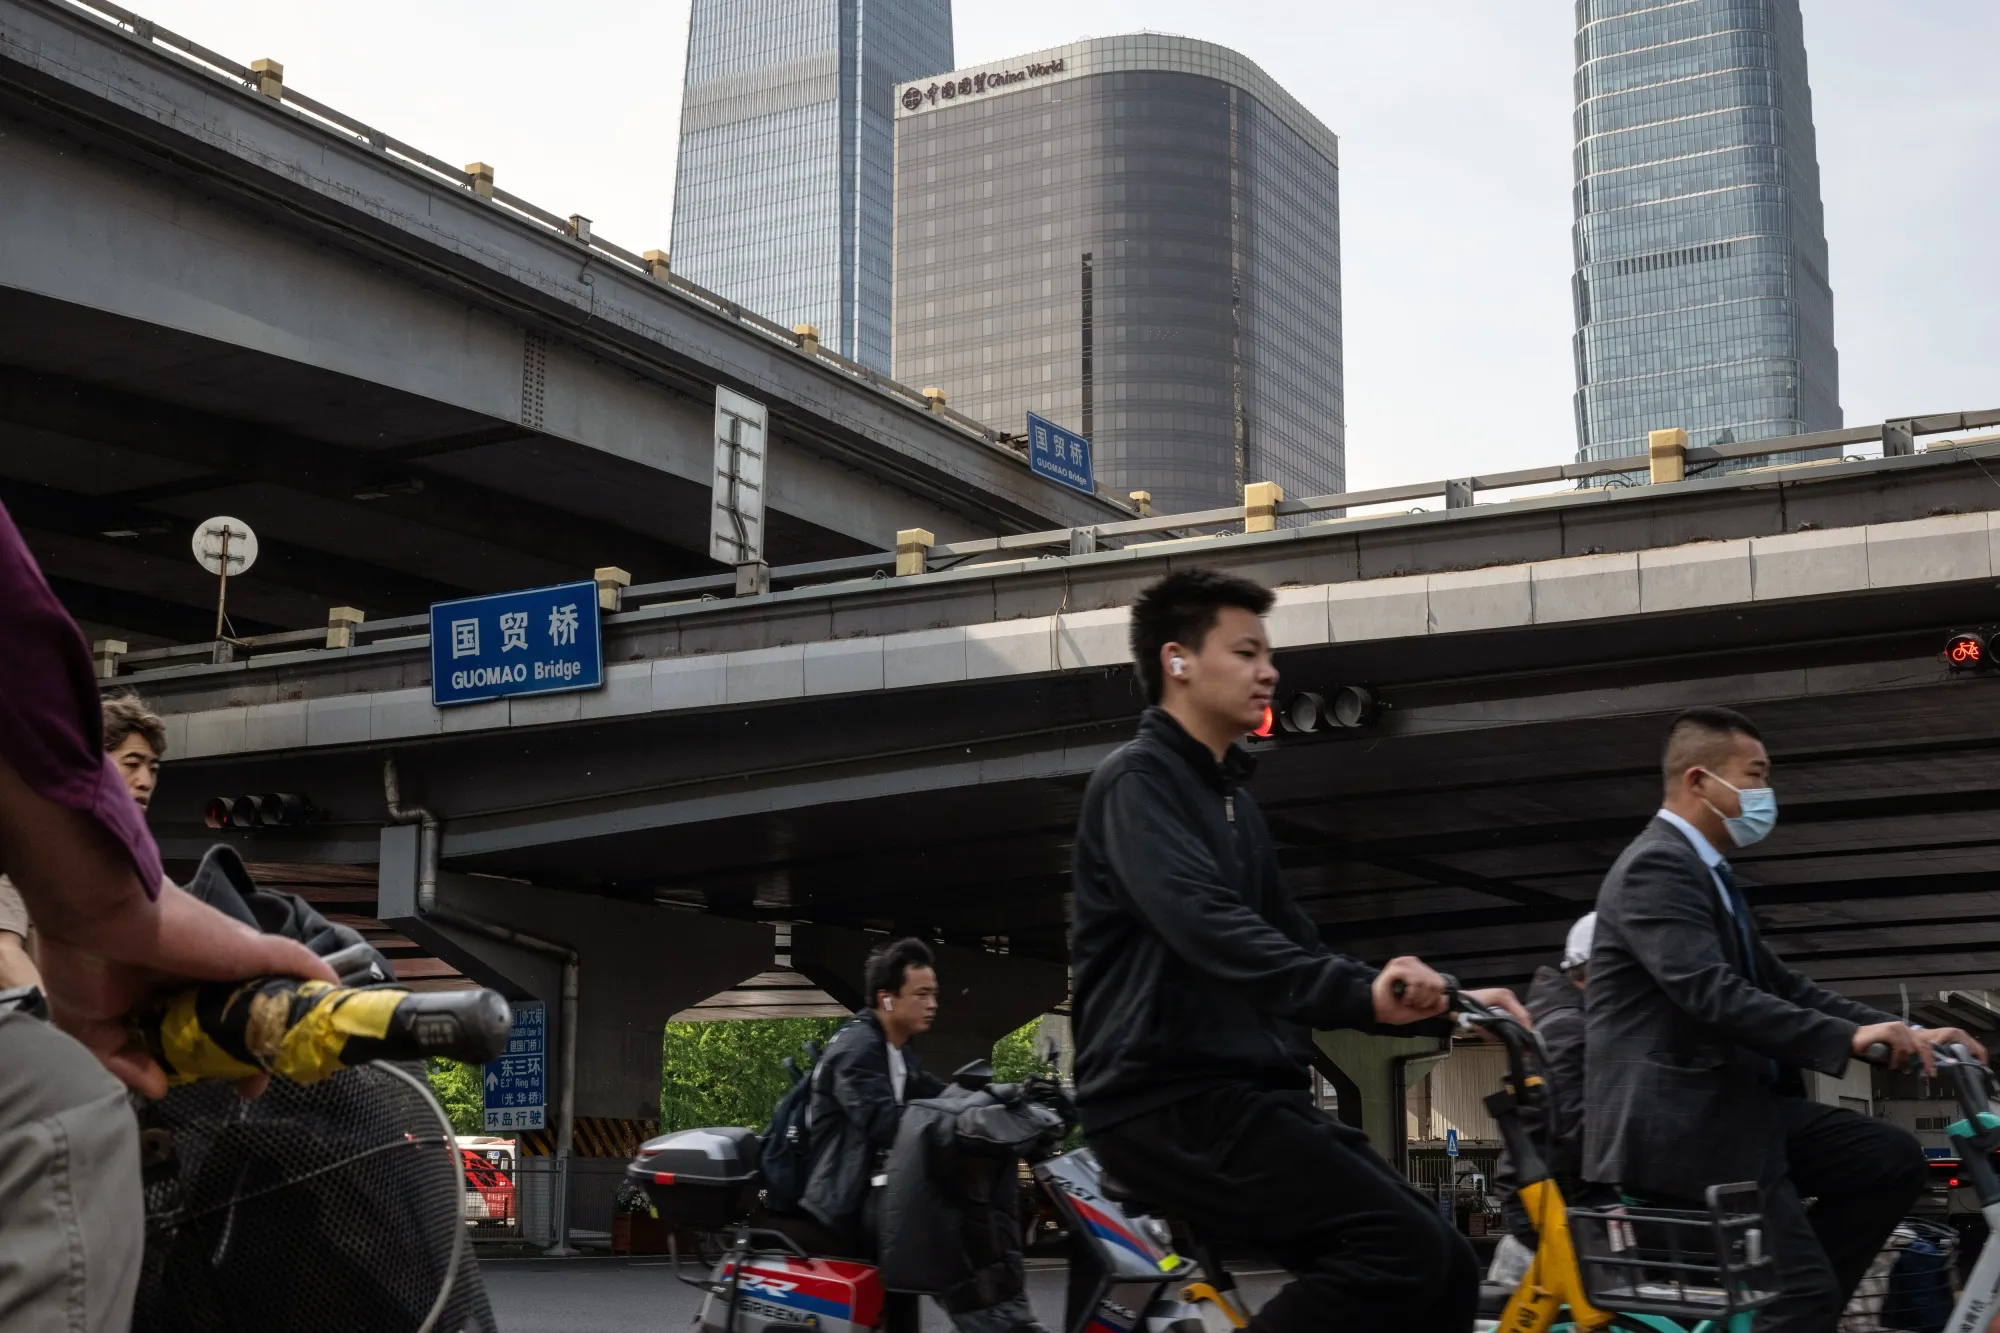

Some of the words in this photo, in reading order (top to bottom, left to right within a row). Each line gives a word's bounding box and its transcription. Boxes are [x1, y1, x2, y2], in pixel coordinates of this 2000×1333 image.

[987, 70, 1024, 88] China
[1026, 59, 1064, 77] World
[1035, 425, 1082, 467] 国贸桥
[1037, 457, 1067, 476] GUOMAO
[1068, 470, 1087, 485] Bridge
[452, 604, 579, 659] 国贸桥
[452, 664, 527, 689] GUOMAO
[534, 659, 581, 680] Bridge
[501, 1057, 541, 1077] 东三环
[515, 1078, 528, 1088] Ring
[531, 1077, 539, 1087] Rd
[487, 1110, 542, 1127] 环岛行驶
